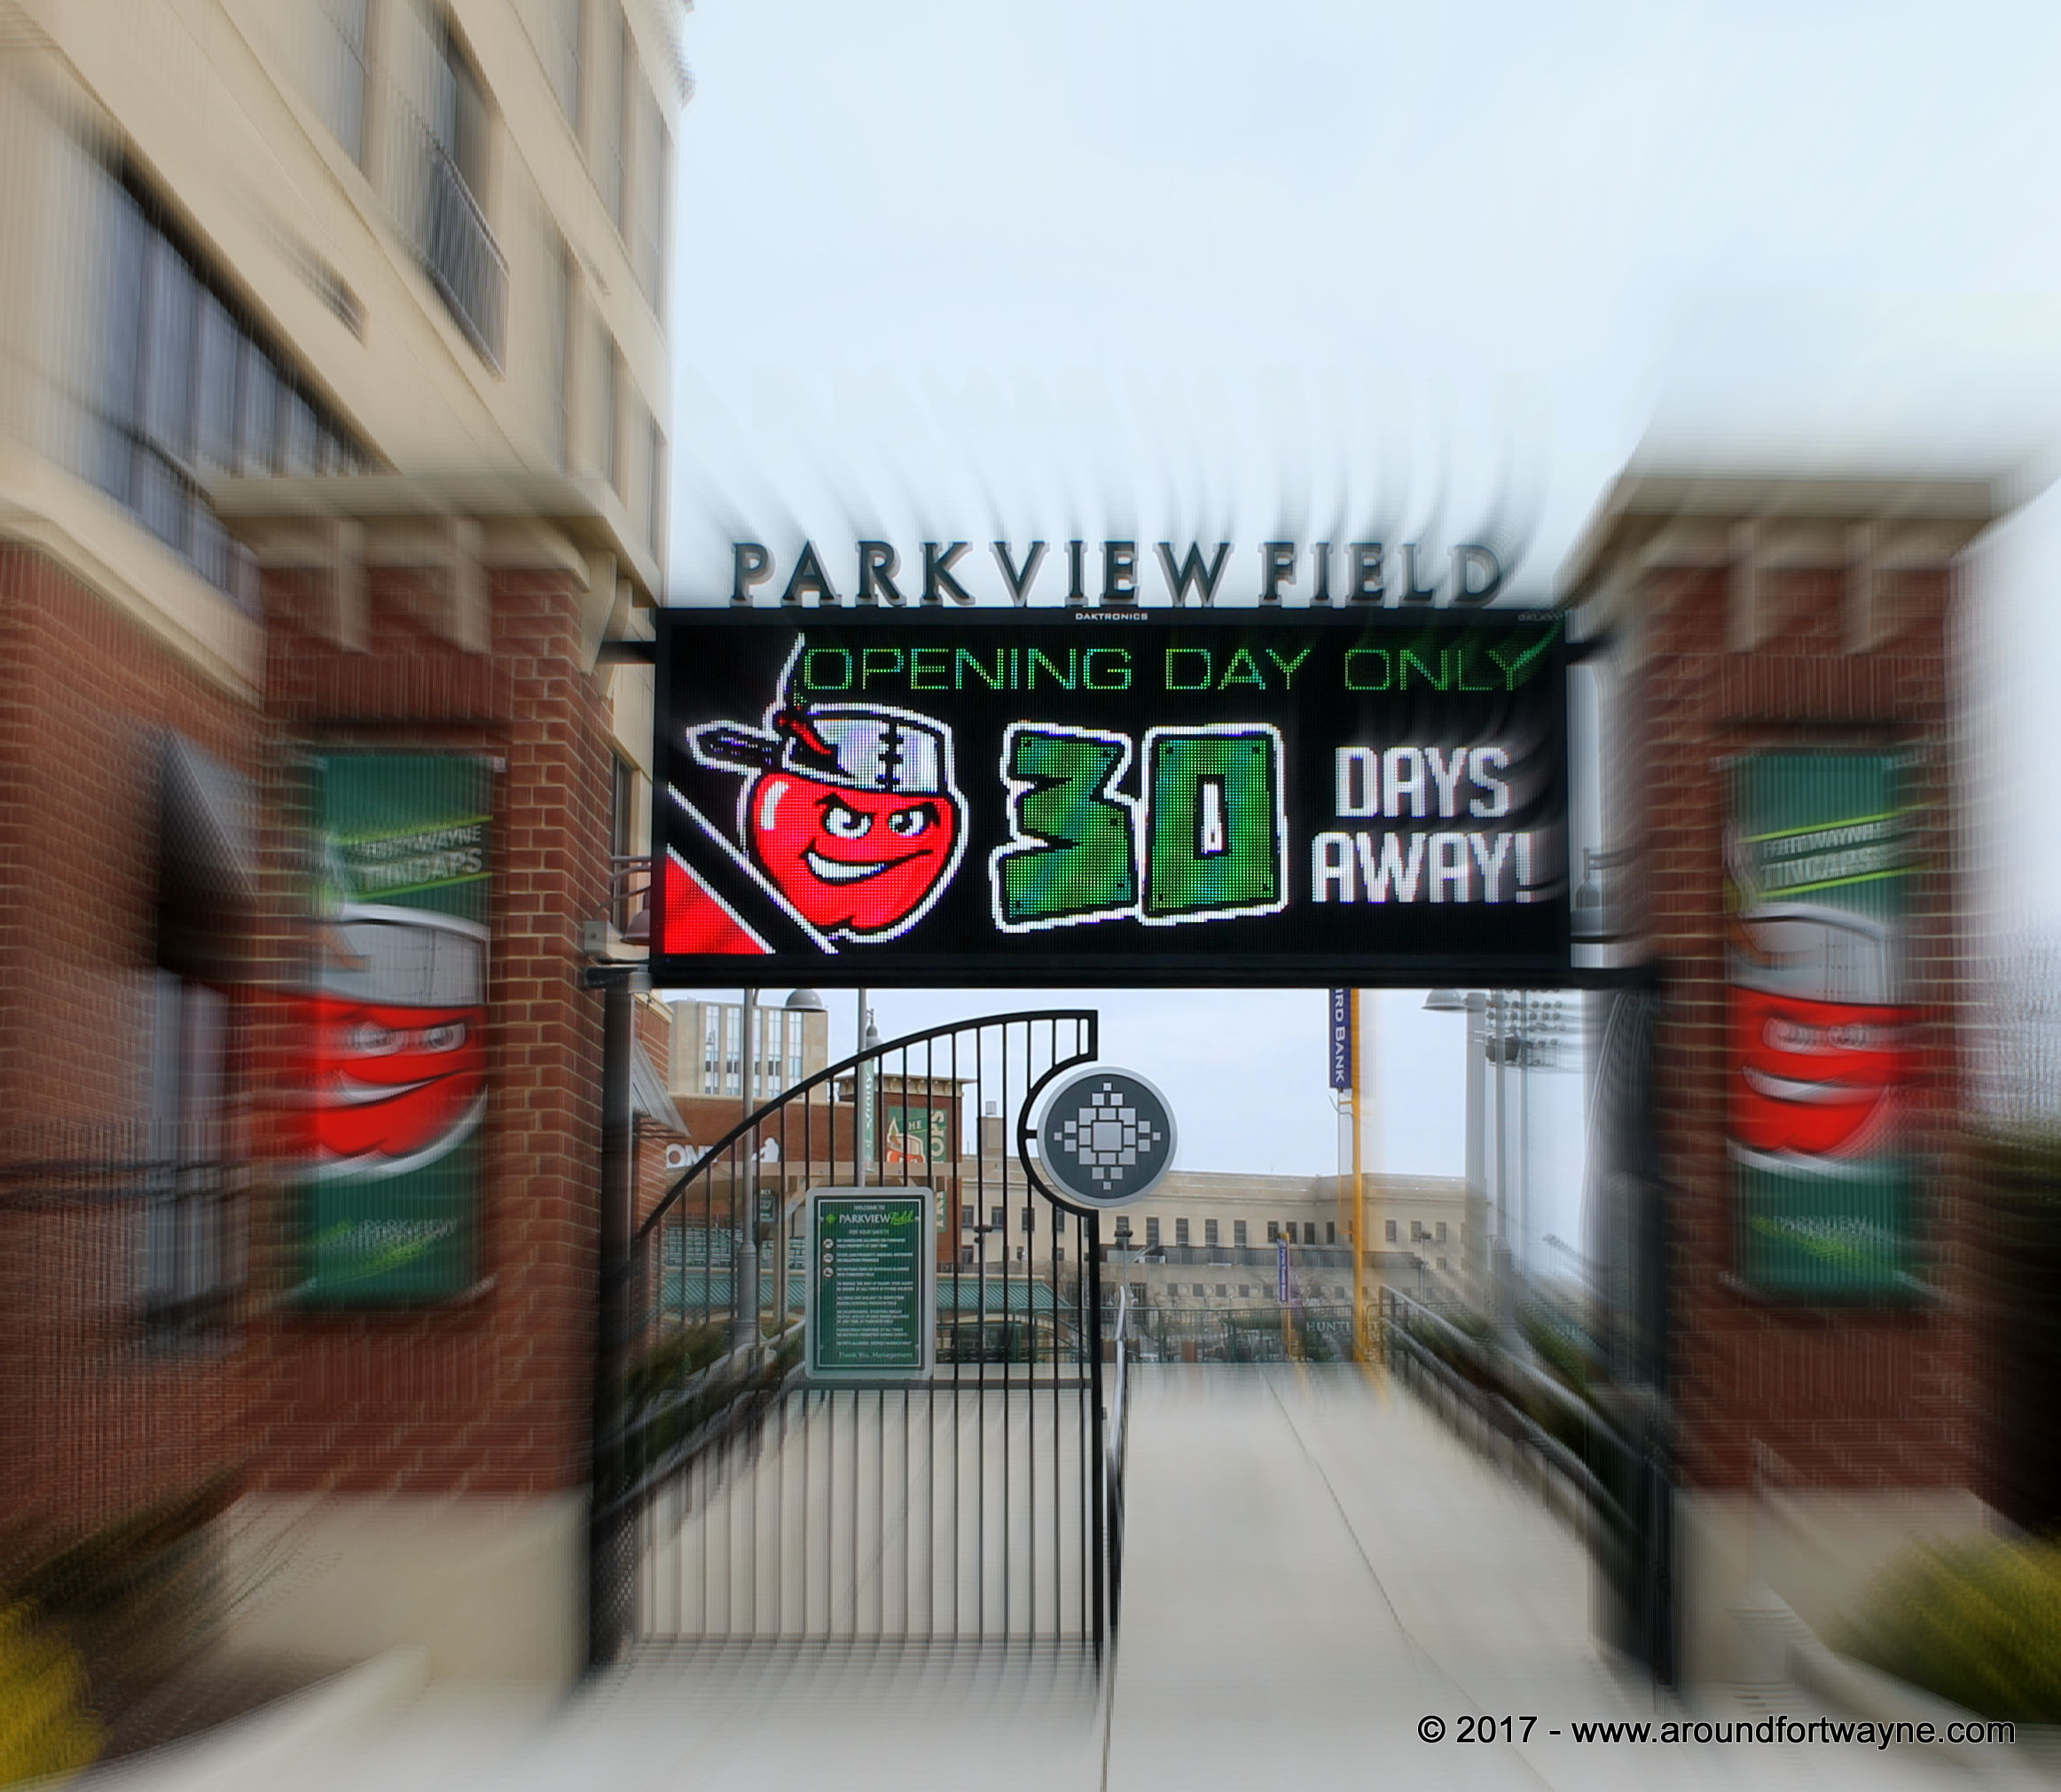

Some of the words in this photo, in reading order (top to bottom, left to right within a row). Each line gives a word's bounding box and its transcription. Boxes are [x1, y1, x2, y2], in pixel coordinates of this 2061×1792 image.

[731, 539, 1233, 606] PARKVIEW
[1258, 540, 1504, 606] FIELD
[1075, 612, 1148, 621] DAKTRONICS
[803, 647, 1132, 690] OPENING
[1165, 647, 1312, 690] DAY
[1344, 647, 1538, 692] ONLY
[1336, 747, 1511, 818] DAYS
[988, 720, 1289, 934] 30
[1312, 832, 1534, 904] AWAY!
[1335, 1026, 1345, 1083] BANK
[839, 1213, 890, 1224] PARKVIEW
